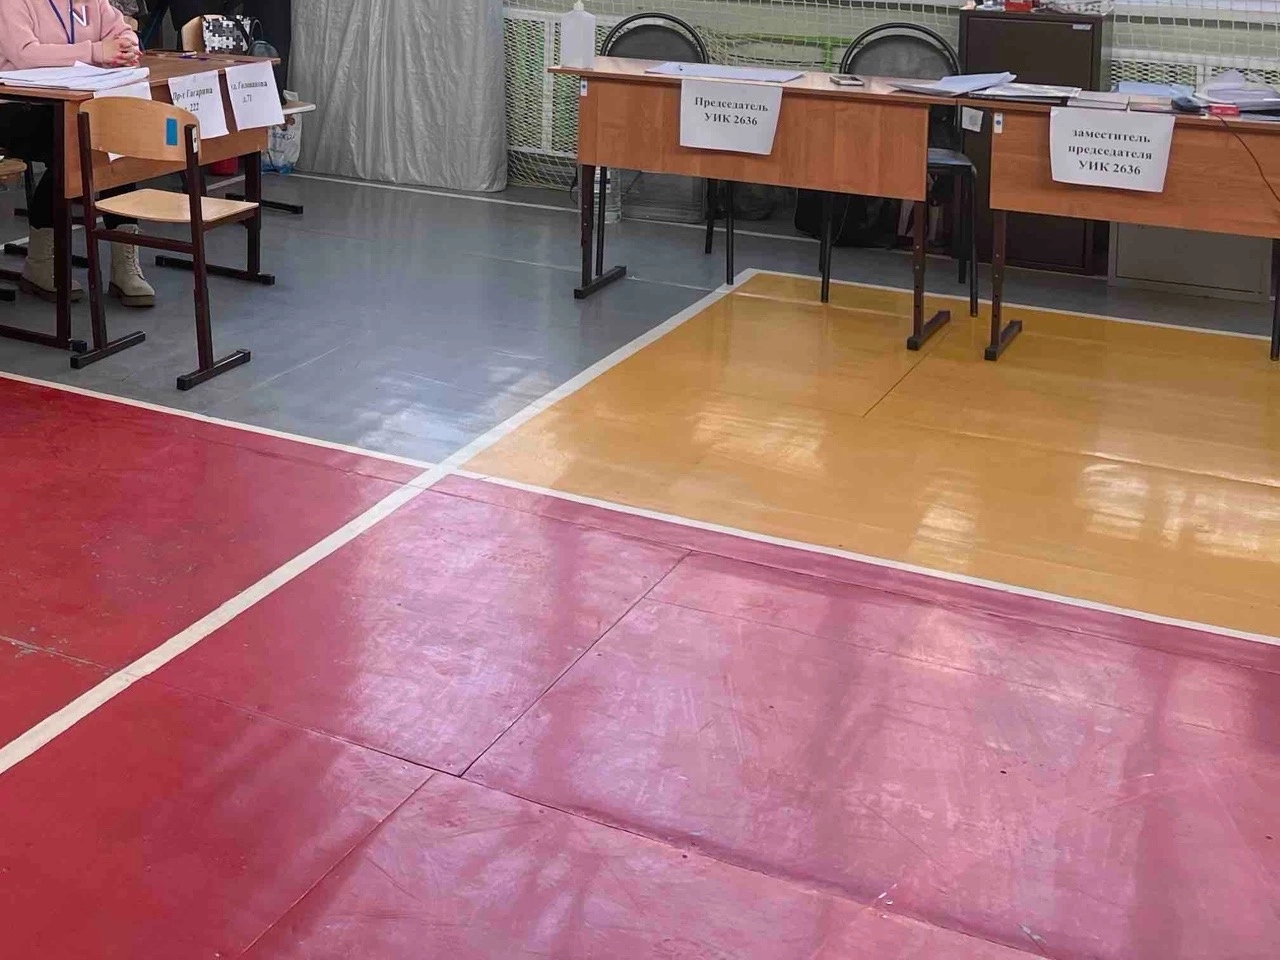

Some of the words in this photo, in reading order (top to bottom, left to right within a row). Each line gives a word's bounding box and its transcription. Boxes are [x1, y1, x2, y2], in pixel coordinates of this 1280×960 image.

[187, 88, 213, 99] Гагарина
[695, 96, 769, 112] Председатель
[704, 113, 731, 124] УИК
[734, 115, 758, 126] 2636
[1072, 129, 1151, 143] заместитель
[1068, 145, 1152, 160] председателя
[1079, 160, 1110, 172] УИК
[1113, 163, 1141, 175] 2636
